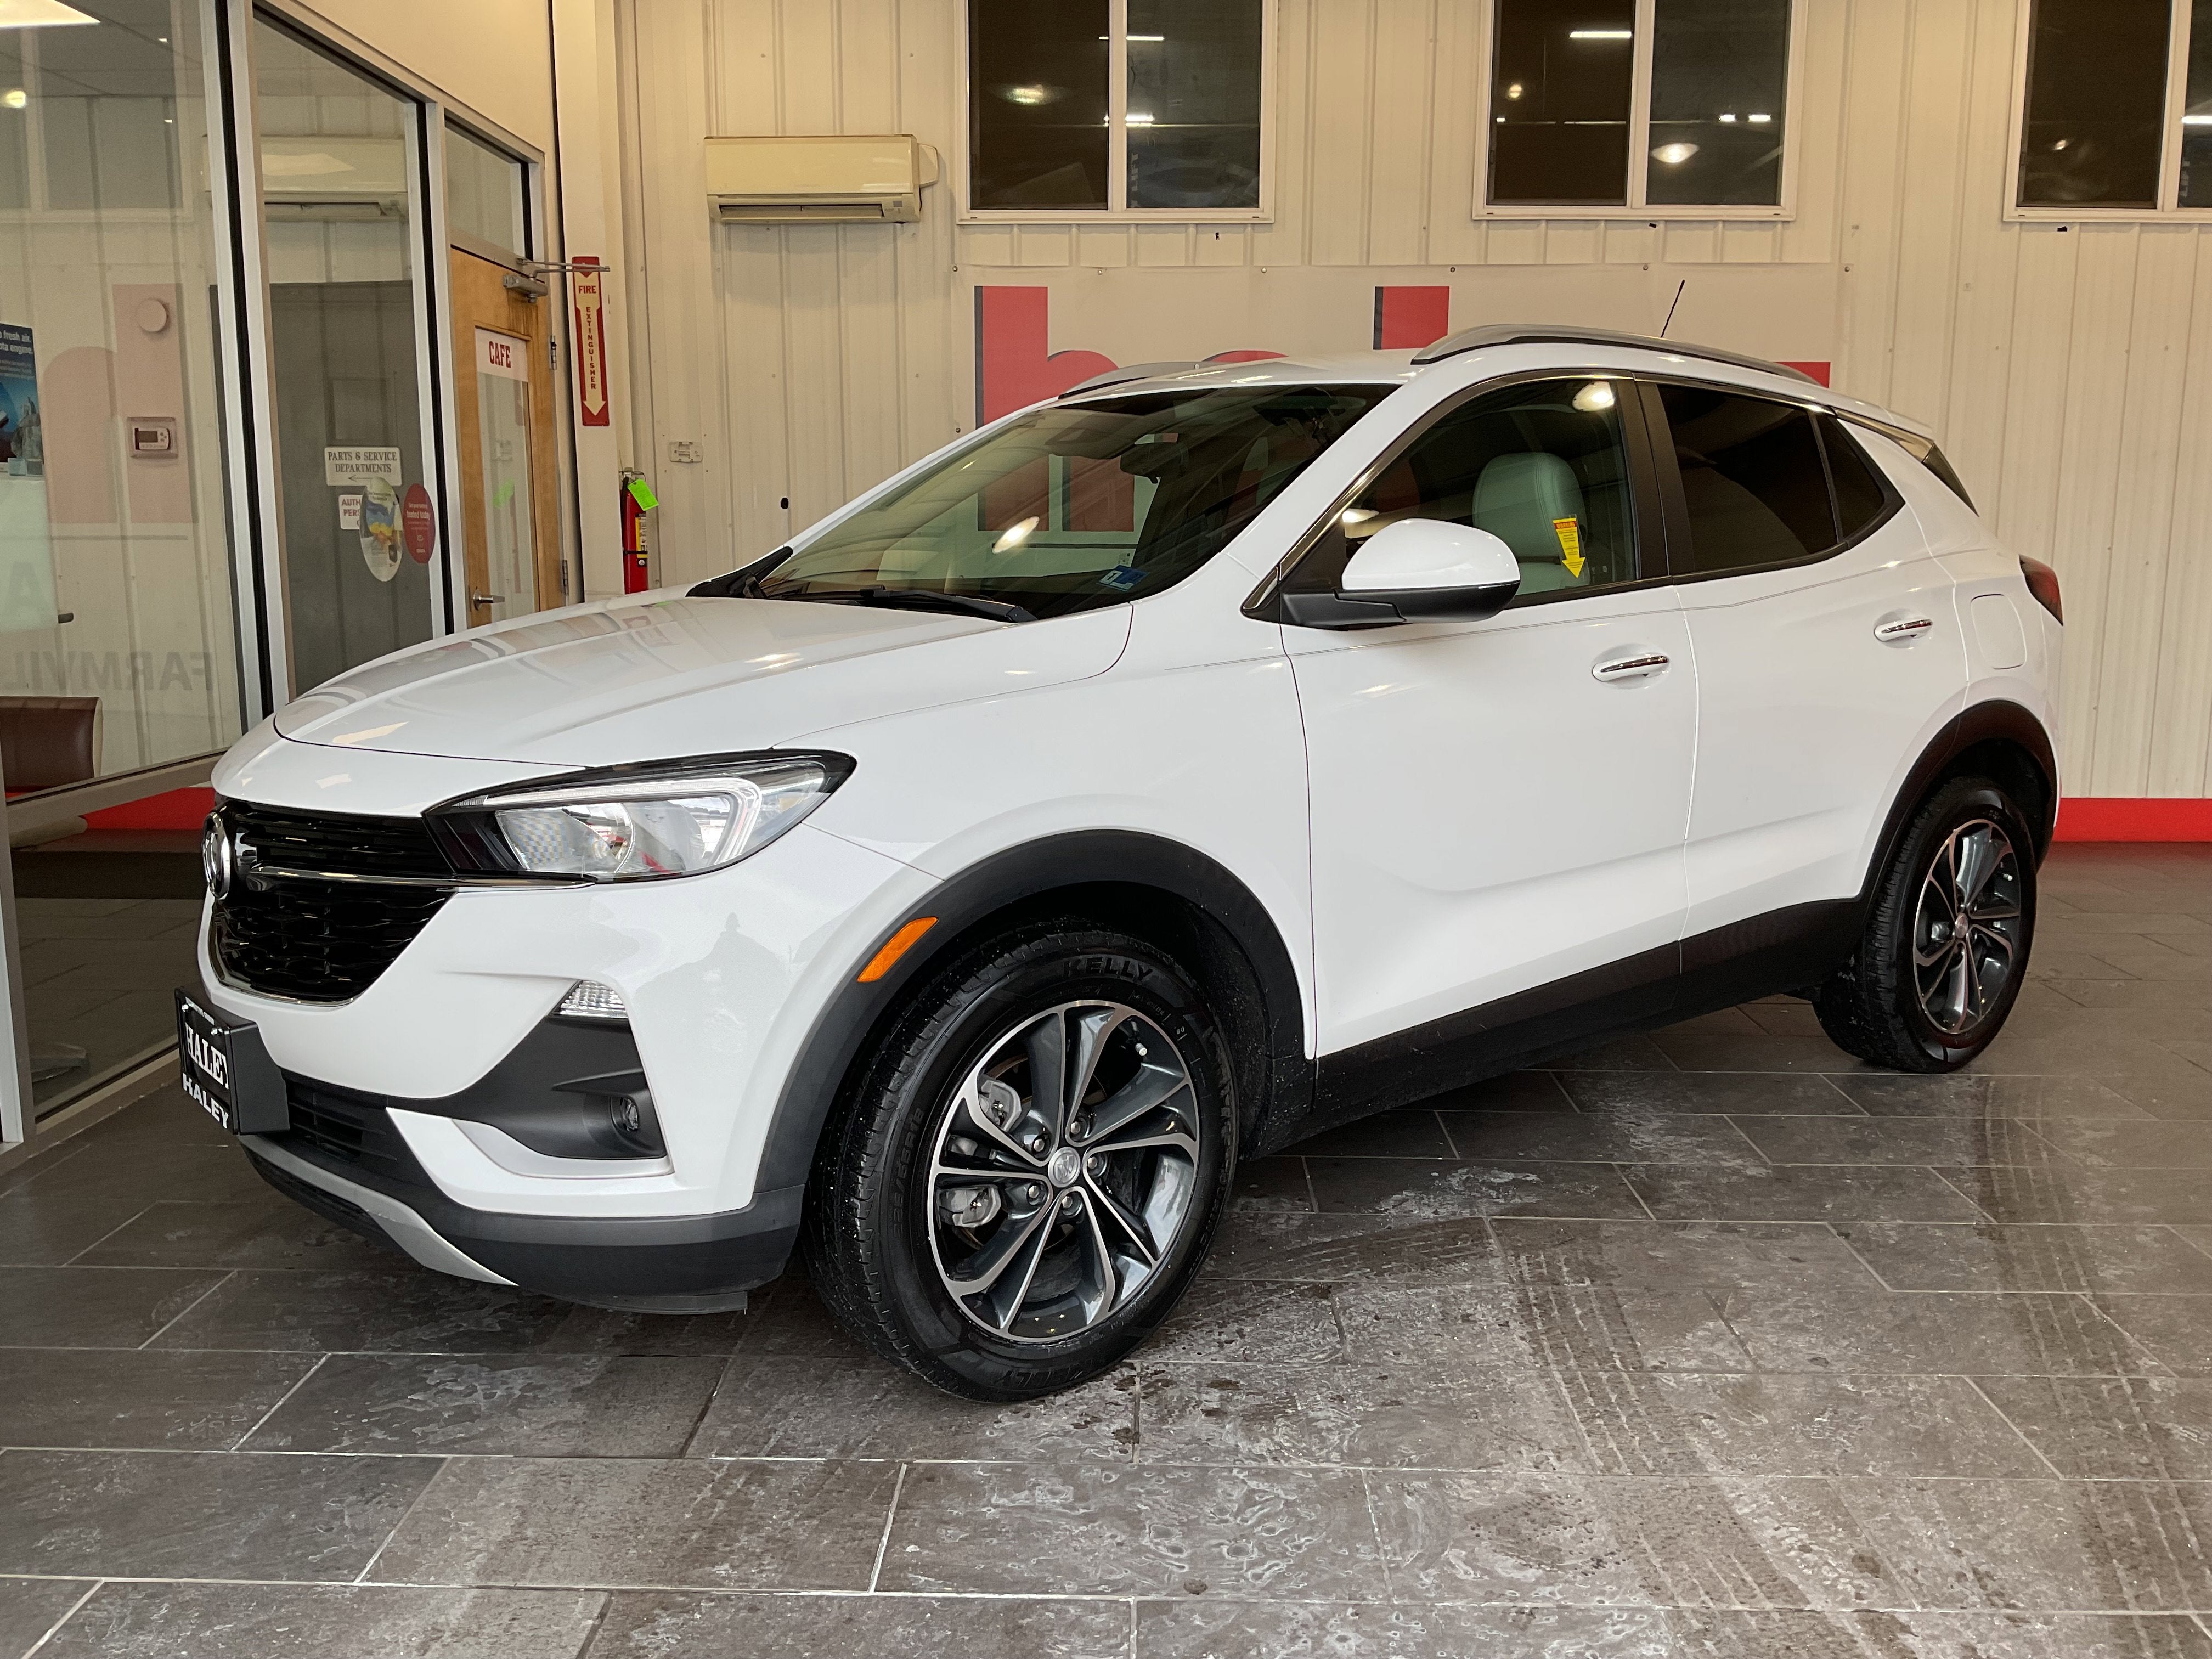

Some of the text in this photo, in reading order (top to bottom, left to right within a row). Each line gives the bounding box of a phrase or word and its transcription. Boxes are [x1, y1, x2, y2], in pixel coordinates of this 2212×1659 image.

[578, 285, 597, 294] FIRE
[489, 341, 512, 369] CAFE
[586, 306, 597, 390] EXTINGUISHER
[328, 451, 398, 461] PARTS & SERVICE
[335, 463, 392, 473] DEPARTMENTS
[1063, 957, 1153, 981] KELLY
[182, 1072, 229, 1129] HALEY
